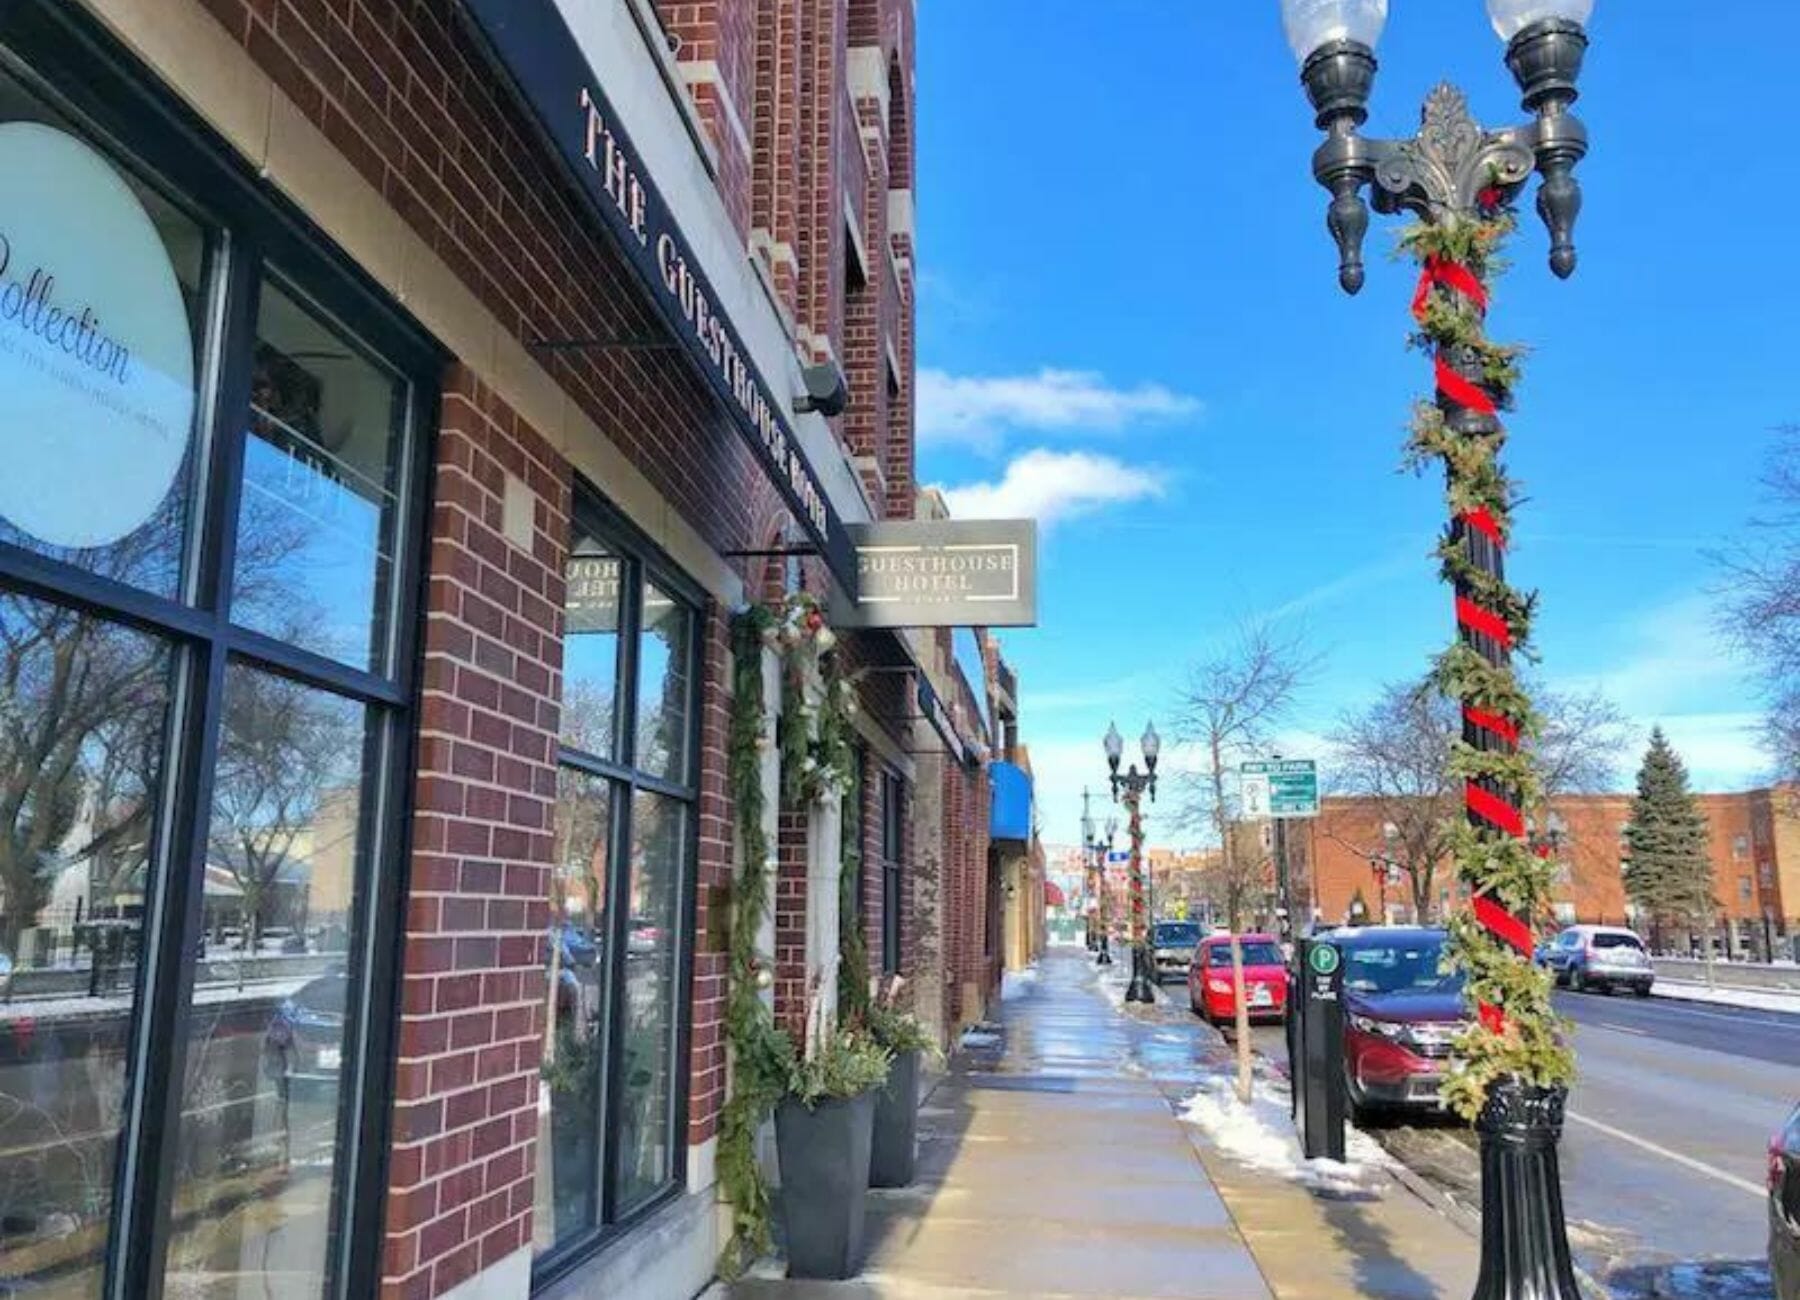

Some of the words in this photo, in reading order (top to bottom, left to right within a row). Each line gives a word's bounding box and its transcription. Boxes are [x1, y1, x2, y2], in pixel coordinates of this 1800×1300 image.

[577, 87, 648, 247] THE
[658, 233, 789, 476] GUESTHOUSE
[790, 449, 829, 543] HOTEL
[894, 573, 973, 592] HOTEL
